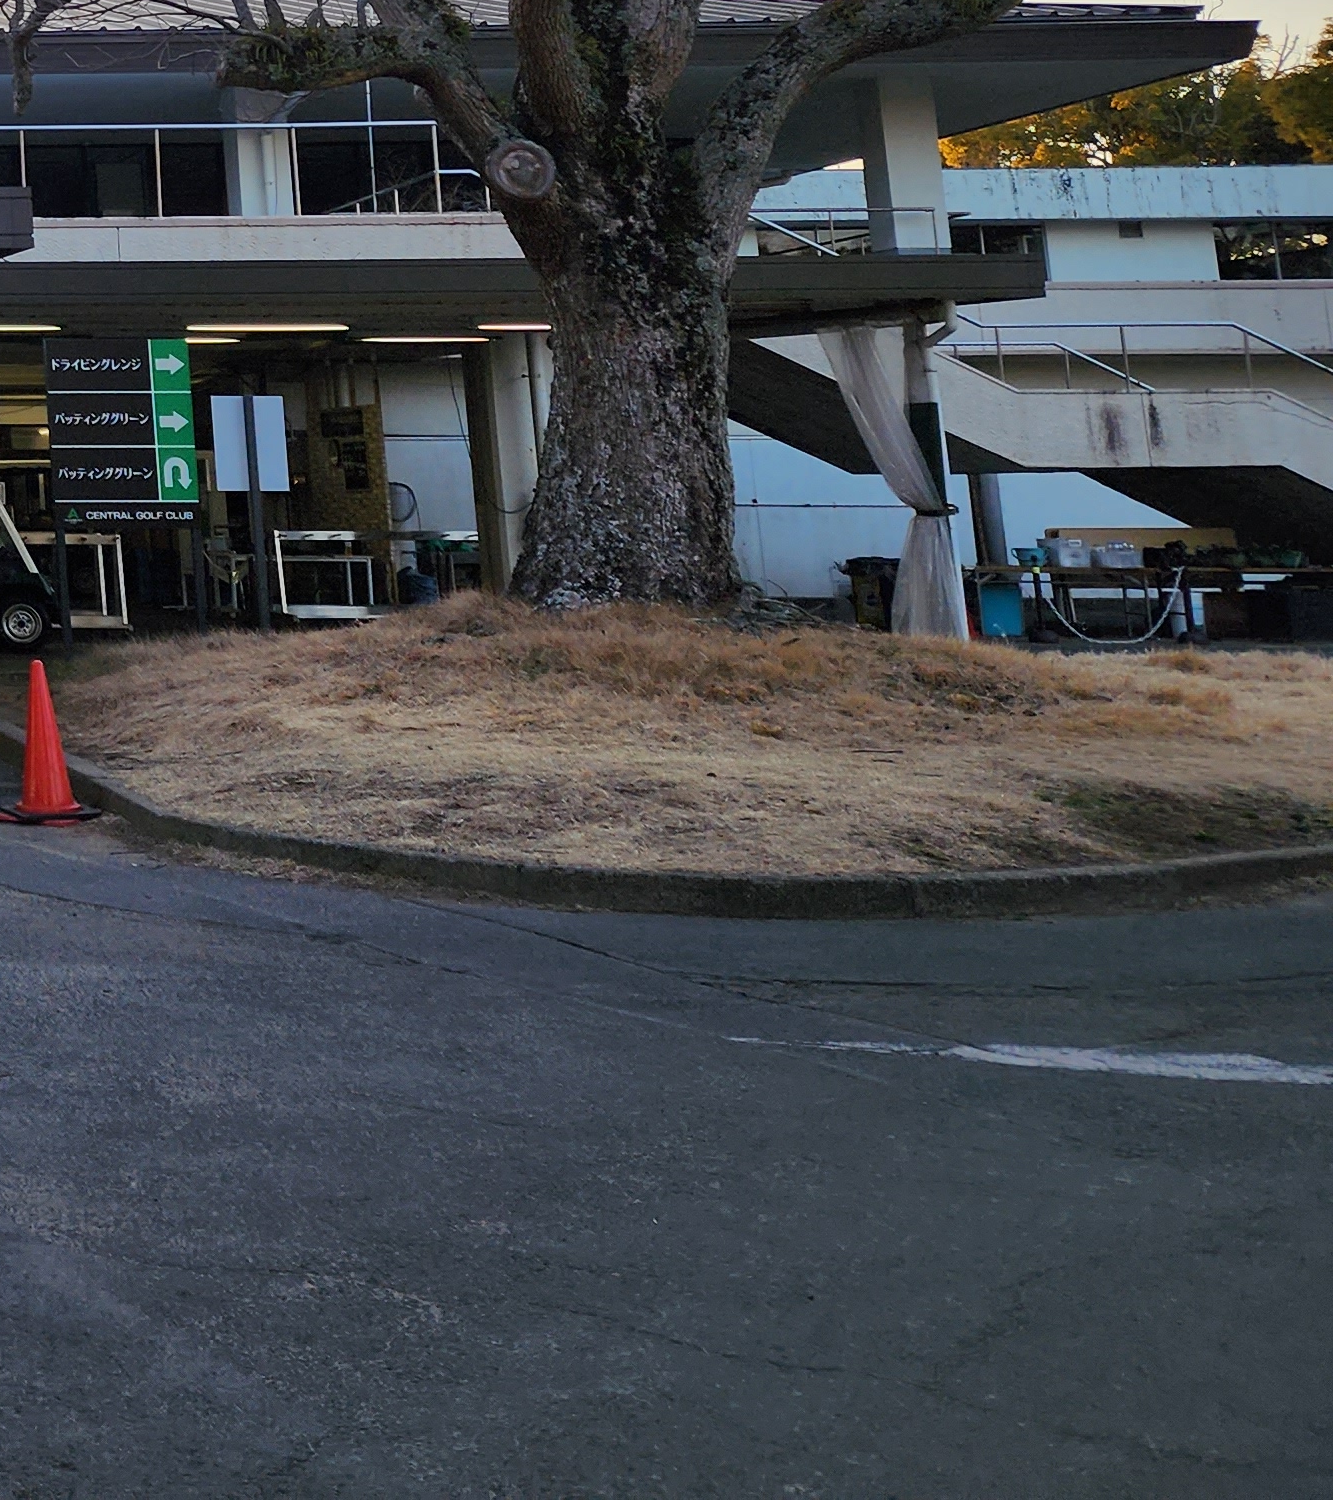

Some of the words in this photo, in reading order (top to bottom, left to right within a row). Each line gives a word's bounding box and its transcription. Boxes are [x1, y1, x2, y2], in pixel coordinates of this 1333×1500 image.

[51, 358, 142, 371] ドライビングレンジ
[54, 412, 149, 425] パッティンググリーン
[58, 467, 153, 479] パッティンググリーン
[85, 511, 134, 520] CENTRAL
[136, 511, 164, 520] GOLF
[165, 511, 194, 520] CLUB
